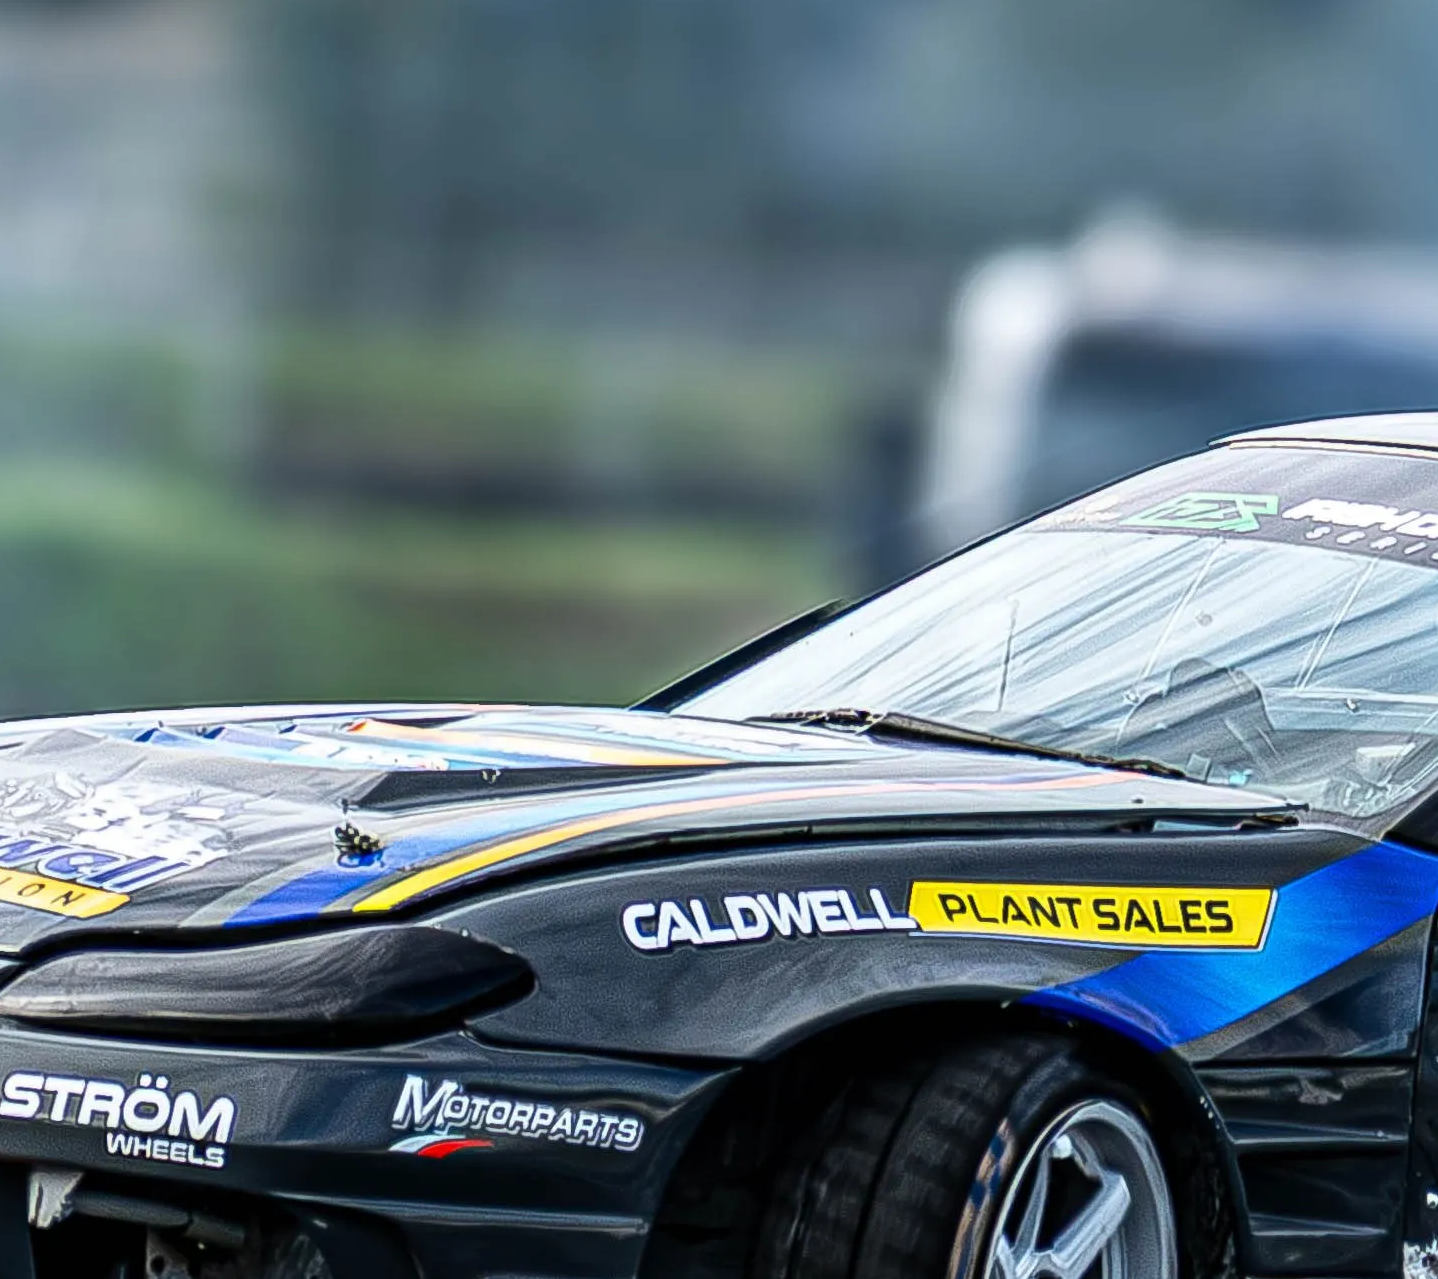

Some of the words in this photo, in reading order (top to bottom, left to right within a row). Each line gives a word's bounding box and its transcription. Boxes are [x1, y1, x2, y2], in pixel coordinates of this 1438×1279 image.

[623, 888, 918, 949] CALDWELL
[938, 893, 1081, 929] PLANT
[1093, 899, 1233, 933] SALES
[0, 1074, 234, 1143] STRÖM
[106, 1132, 225, 1168] WHEELS
